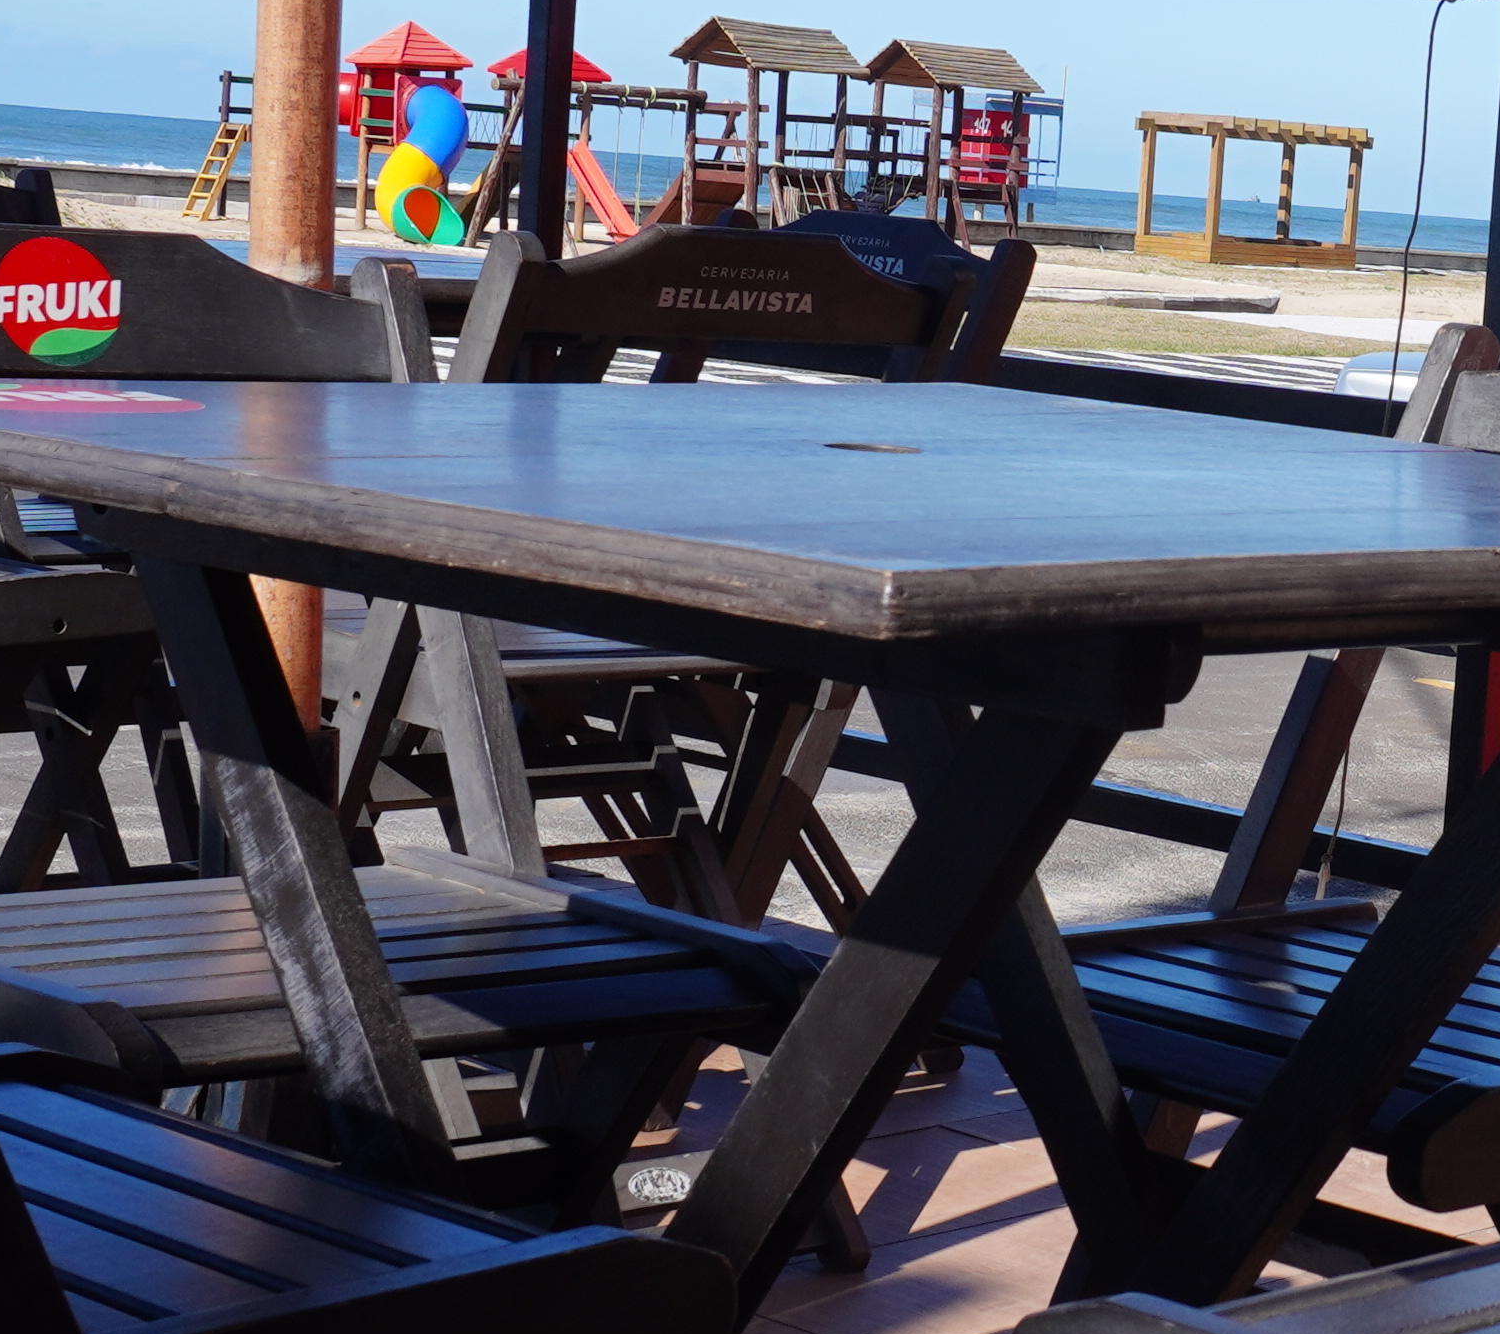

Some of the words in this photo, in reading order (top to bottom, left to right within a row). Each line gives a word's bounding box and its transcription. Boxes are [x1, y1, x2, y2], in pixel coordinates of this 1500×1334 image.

[700, 266, 792, 282] CERVEJARIA
[857, 253, 905, 276] VISTA
[657, 286, 813, 316] BELLAVISTA
